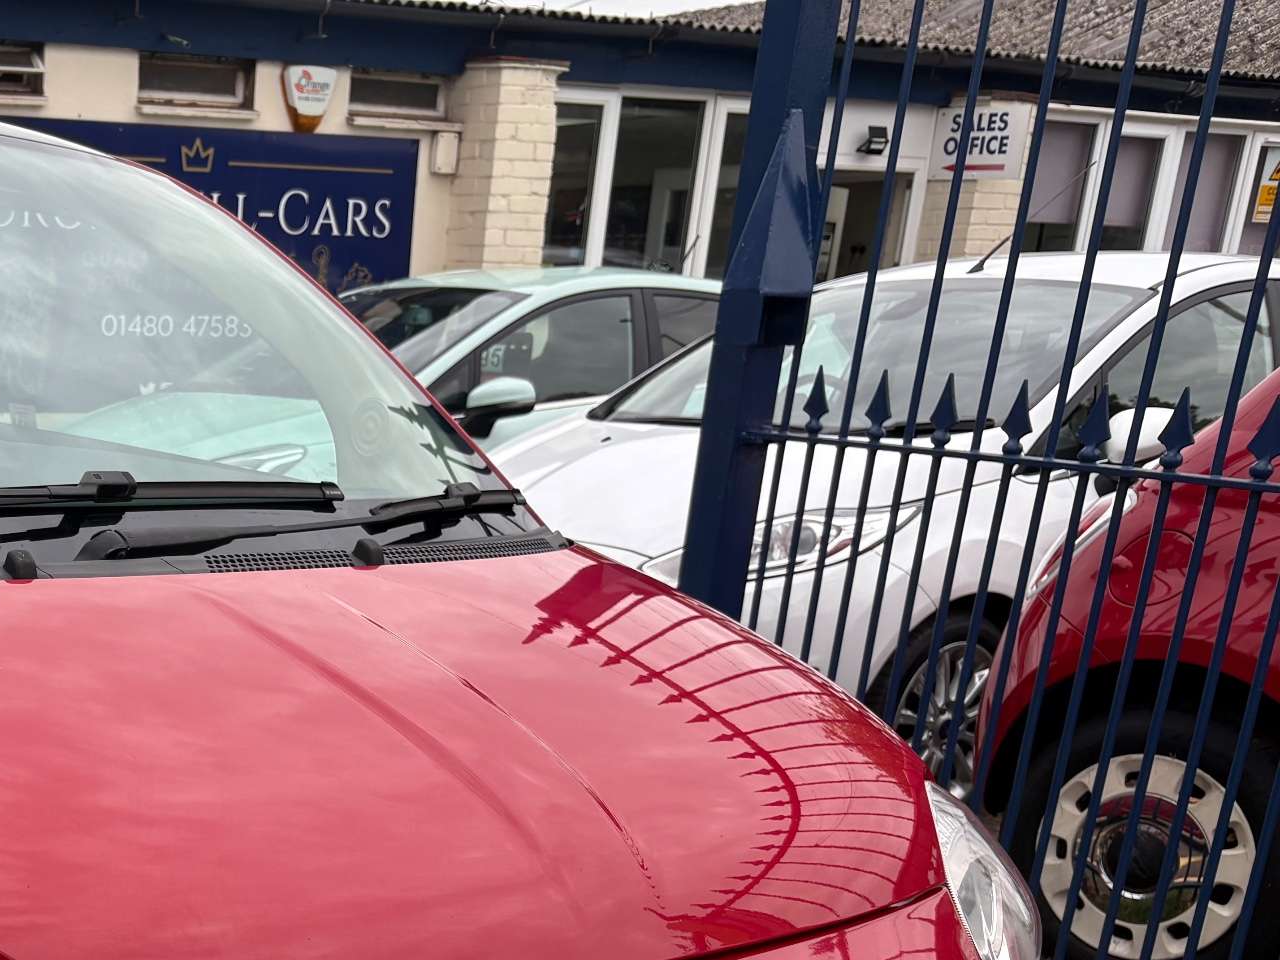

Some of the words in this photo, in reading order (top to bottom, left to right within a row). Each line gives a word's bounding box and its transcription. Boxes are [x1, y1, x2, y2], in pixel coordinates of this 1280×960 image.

[951, 112, 1009, 133] SLES
[944, 135, 1009, 155] OFICE
[101, 314, 173, 337] 01480
